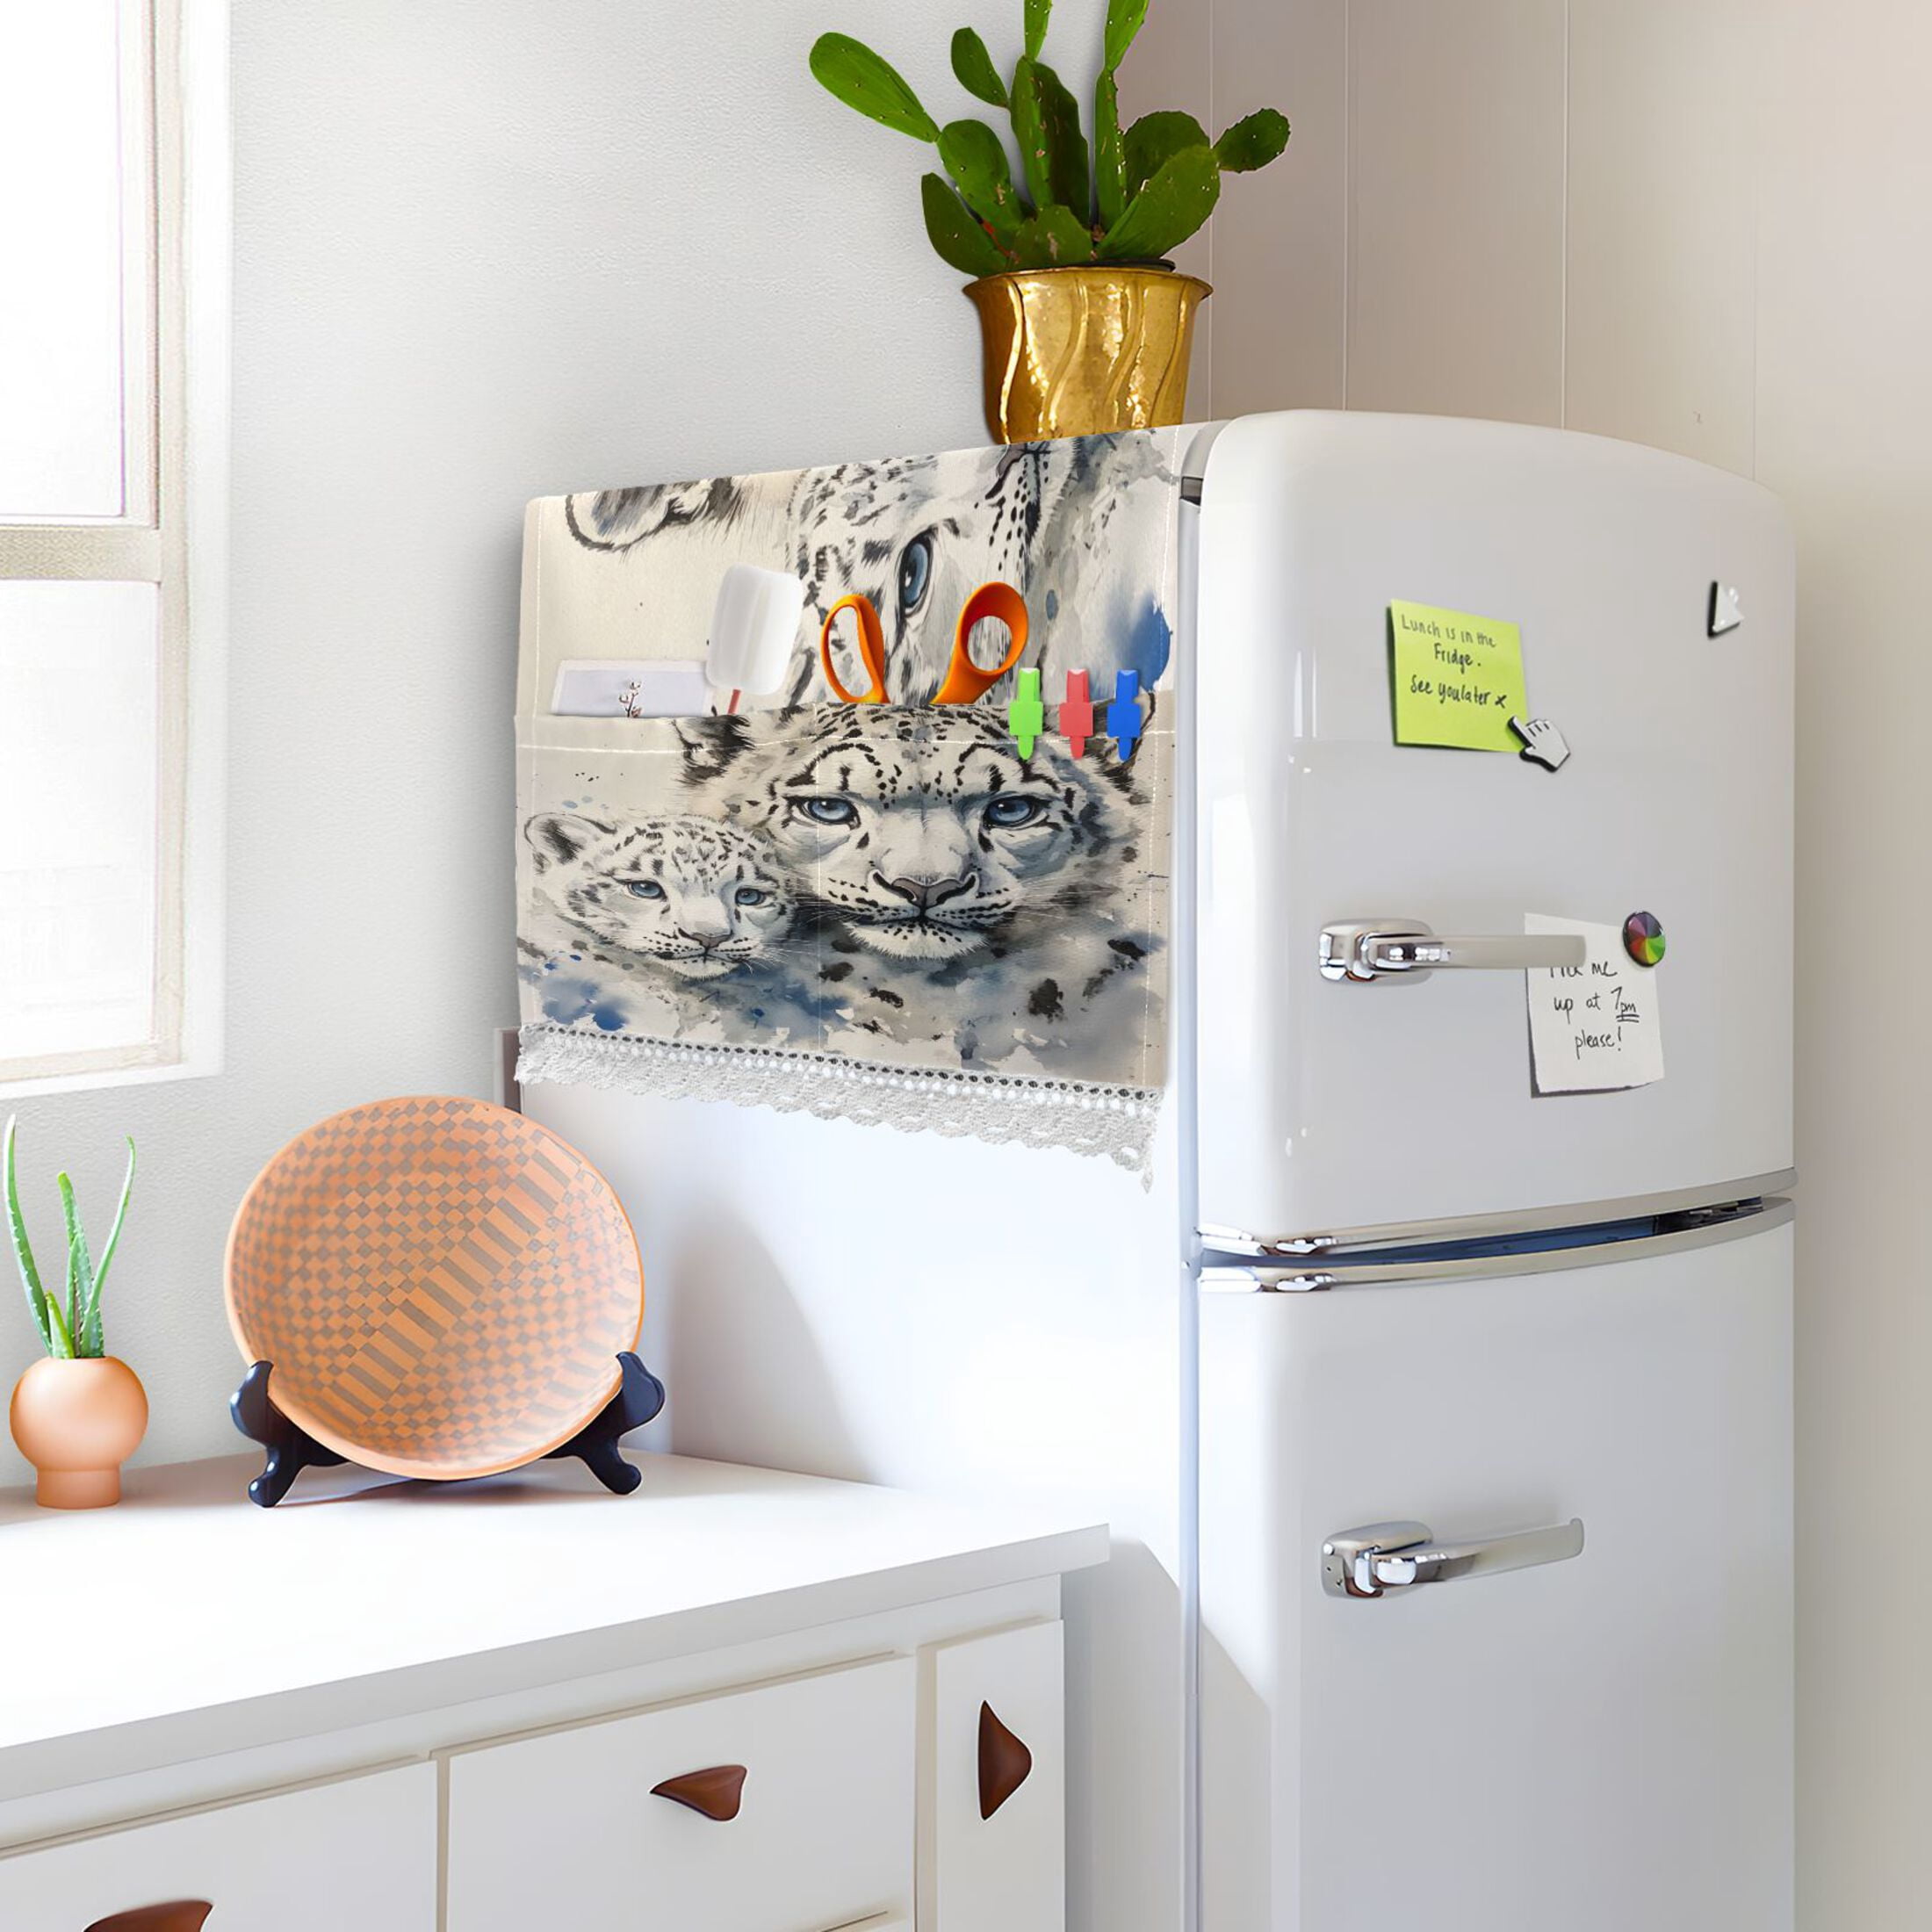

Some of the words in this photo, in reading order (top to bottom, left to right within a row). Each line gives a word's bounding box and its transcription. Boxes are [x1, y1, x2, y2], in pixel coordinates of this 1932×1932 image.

[1402, 614, 1441, 638] Lunch
[1461, 631, 1474, 644] in
[1477, 631, 1496, 648] the
[1410, 674, 1433, 695] See
[1591, 961, 1618, 977] me
[1554, 997, 1574, 1025] up
[1586, 991, 1601, 1011] at
[1575, 1026, 1622, 1060] please!
